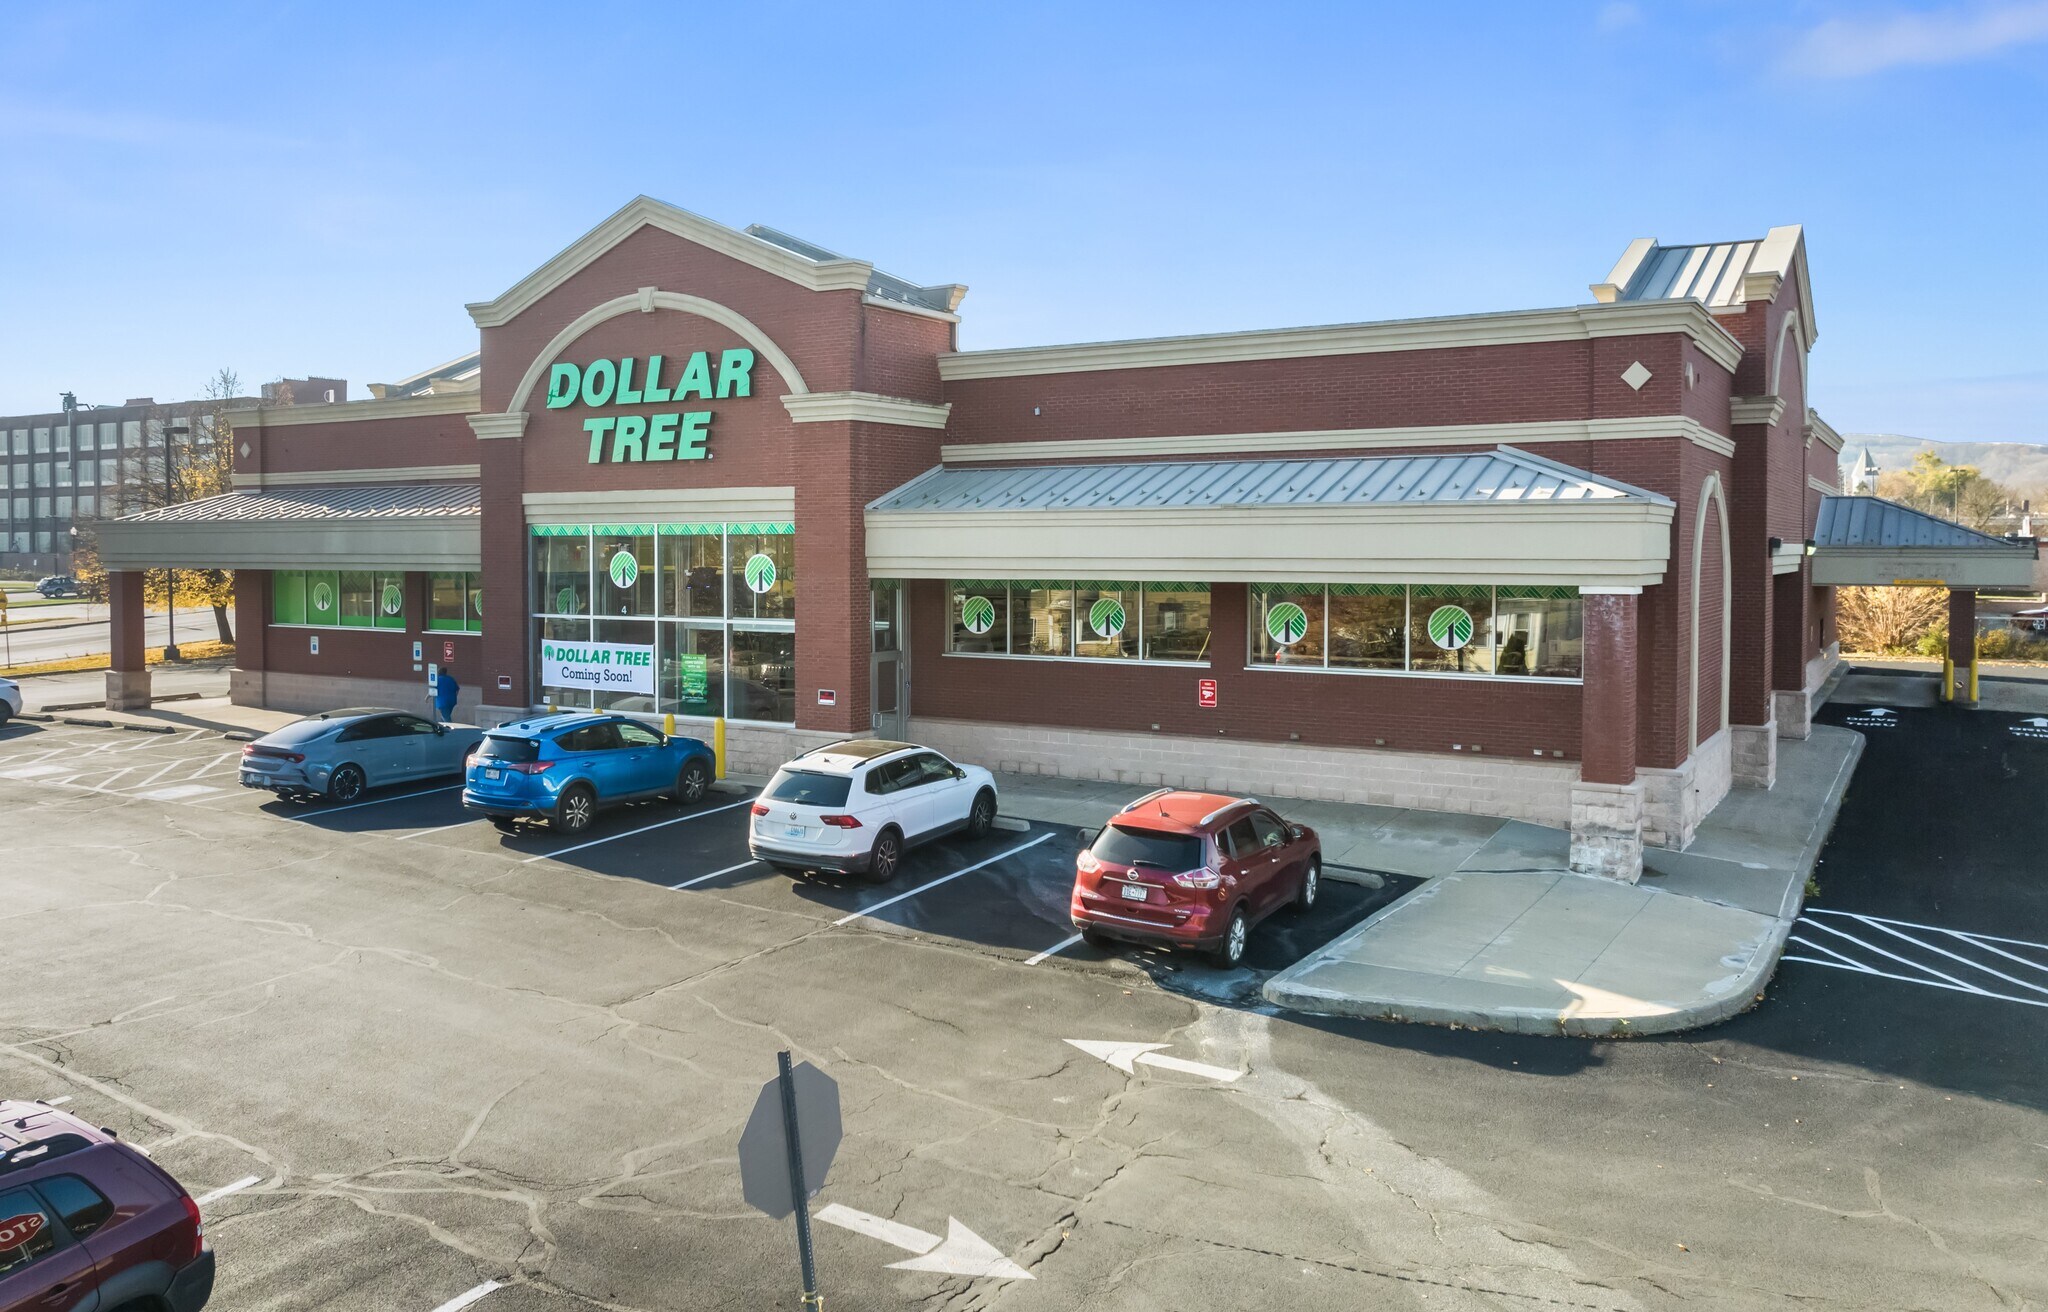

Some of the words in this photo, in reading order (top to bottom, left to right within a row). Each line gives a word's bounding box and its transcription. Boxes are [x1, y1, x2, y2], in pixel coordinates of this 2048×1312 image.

[546, 348, 755, 410] DOLLAR
[583, 411, 712, 464] TREE
[621, 605, 628, 615] 4
[556, 647, 611, 664] DOLLAR
[615, 650, 650, 666] TREE
[561, 666, 601, 683] Coming
[603, 669, 633, 683] Soon!
